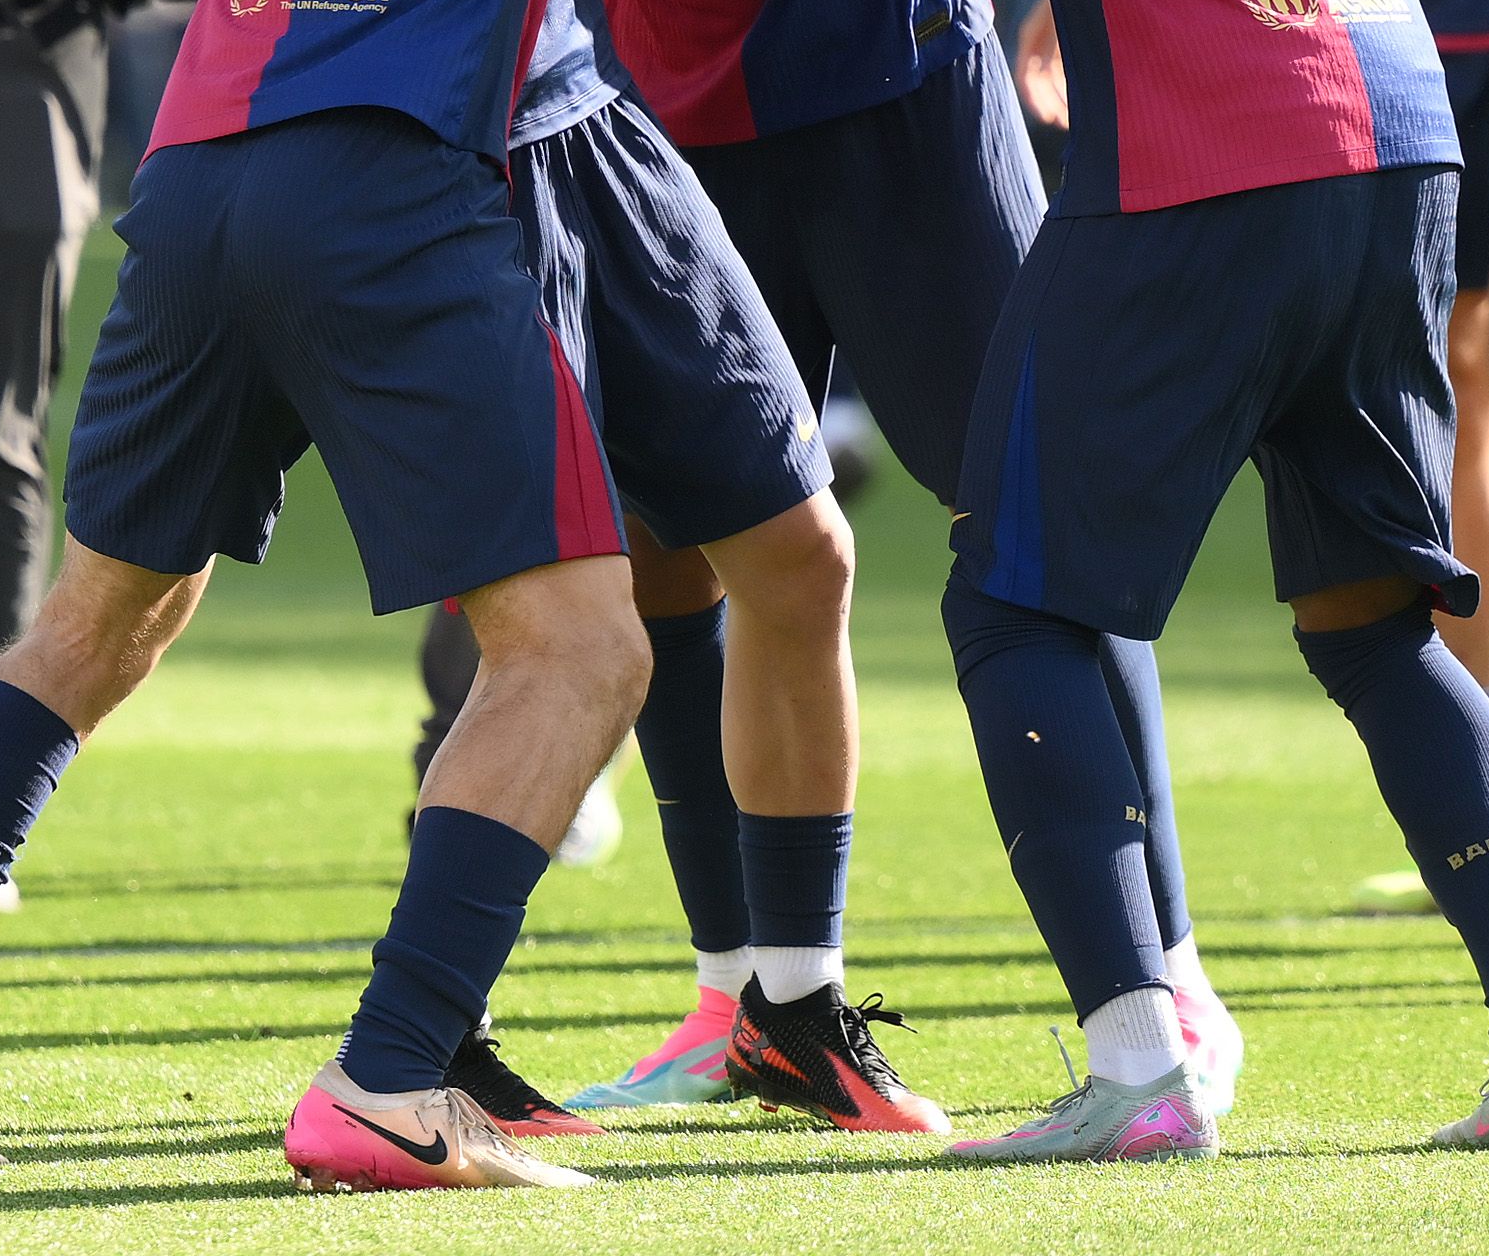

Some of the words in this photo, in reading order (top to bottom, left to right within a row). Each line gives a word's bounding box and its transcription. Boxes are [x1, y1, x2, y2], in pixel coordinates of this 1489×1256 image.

[280, 1, 295, 10] The
[296, 1, 311, 10] UN
[312, 1, 350, 12] Refugee
[351, 2, 387, 14] Agency
